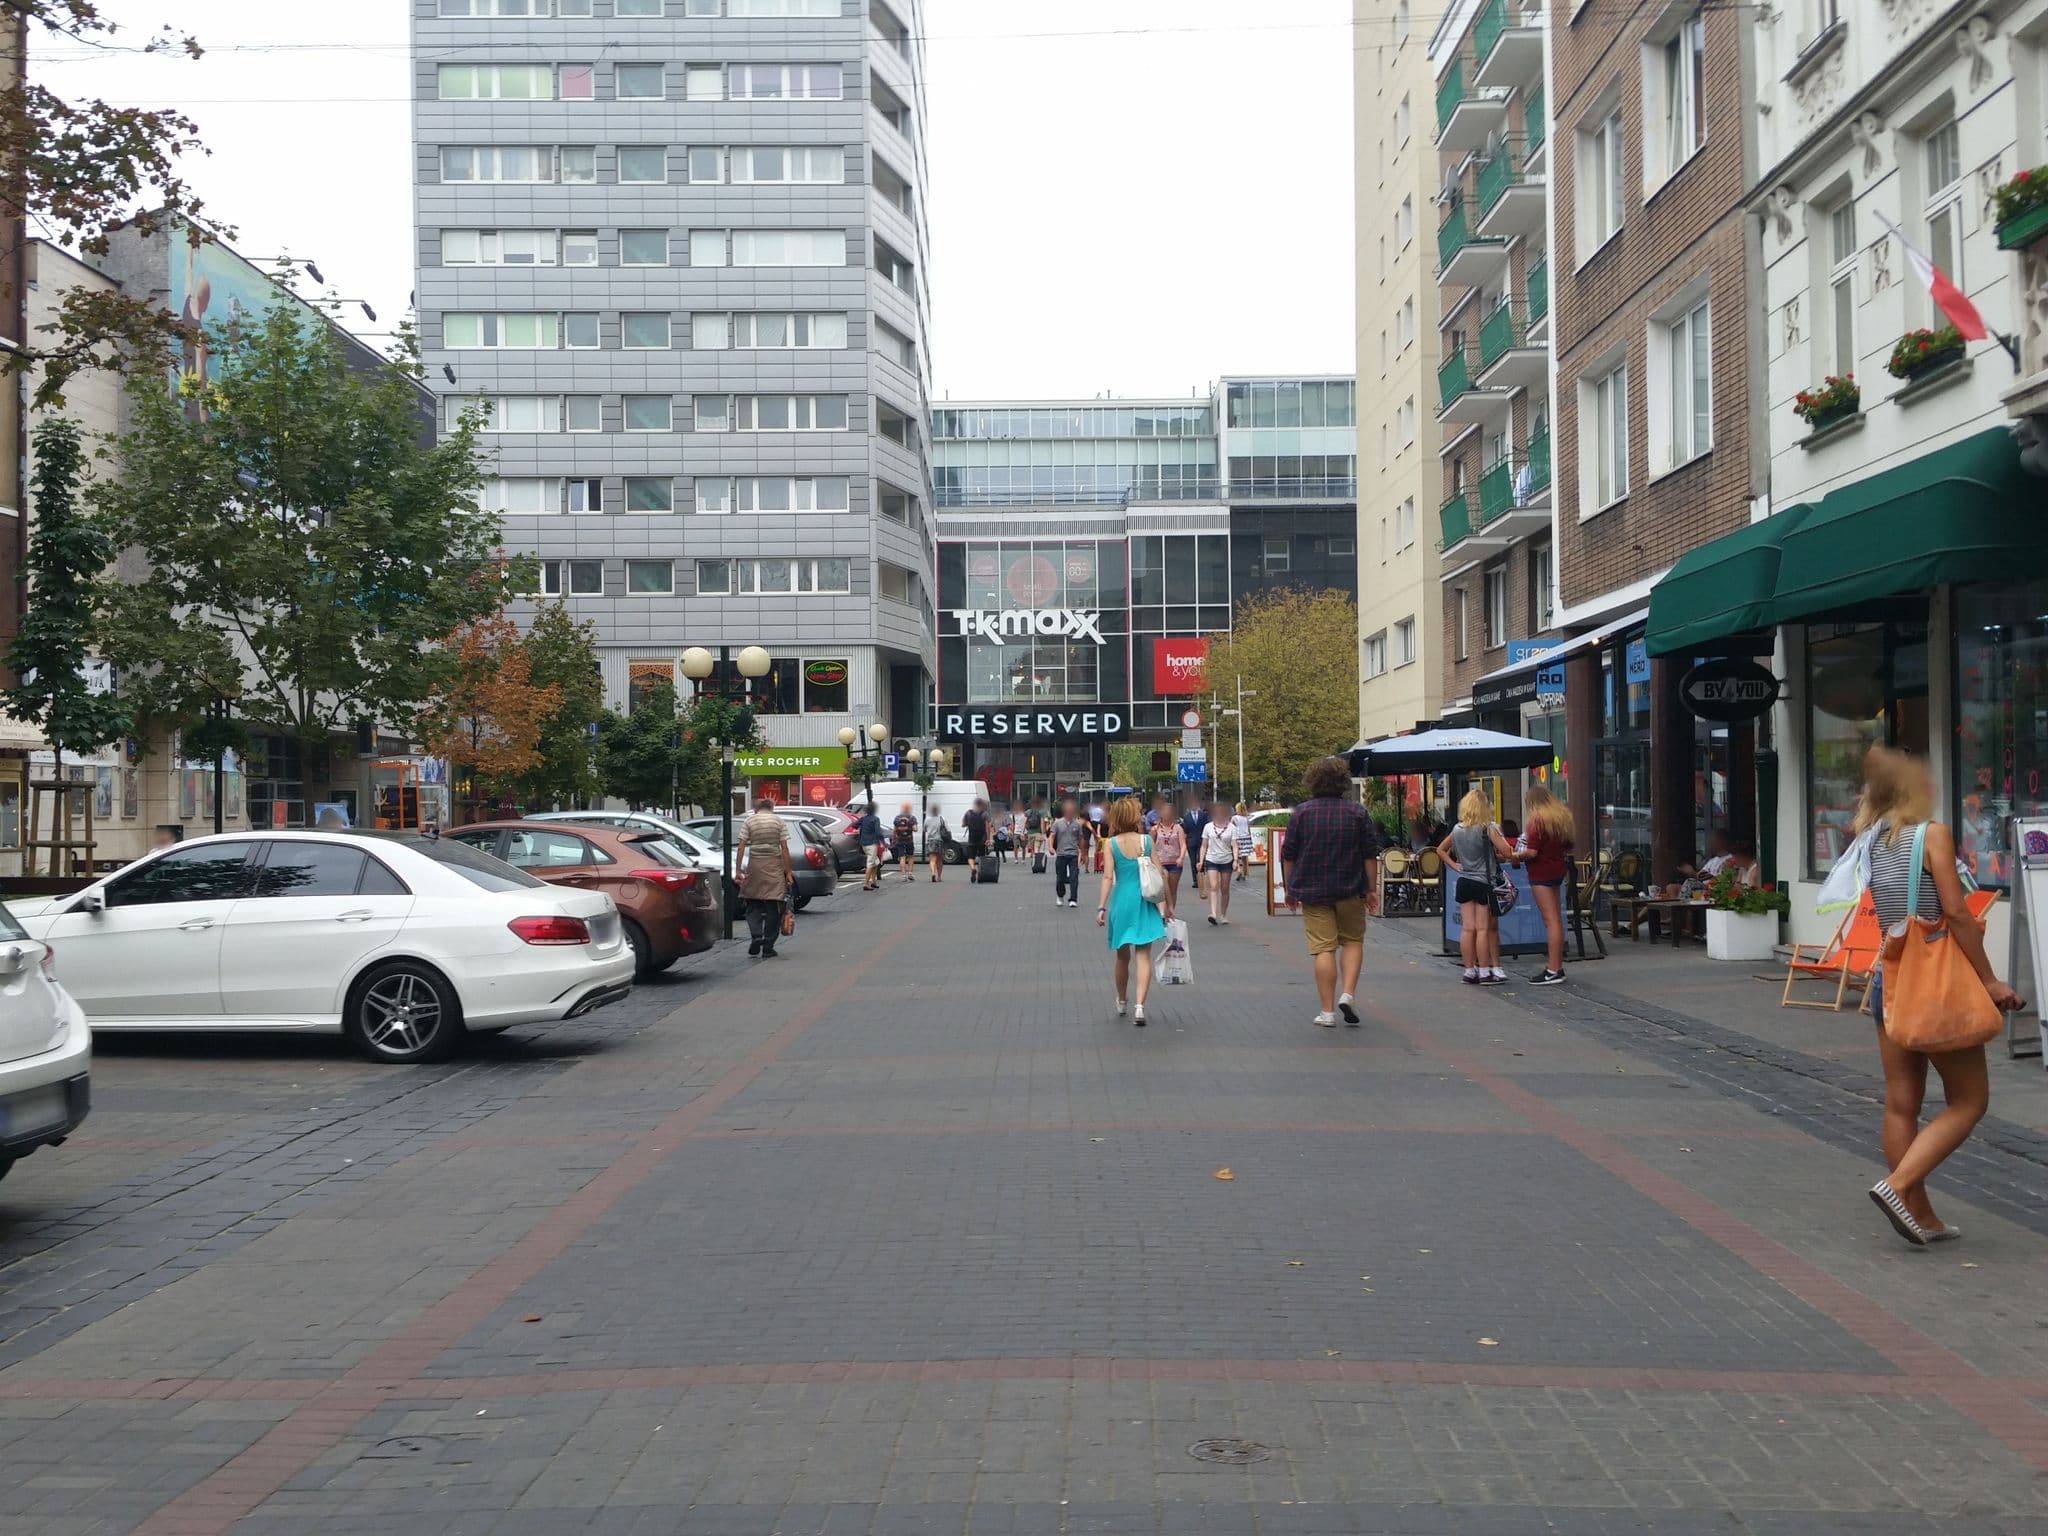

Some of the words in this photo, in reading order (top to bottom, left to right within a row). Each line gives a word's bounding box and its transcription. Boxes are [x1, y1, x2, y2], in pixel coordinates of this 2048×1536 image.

[1166, 653, 1205, 667] home
[946, 713, 1122, 735] RESERVED
[733, 757, 763, 767] YVES
[767, 756, 820, 767] ROCHER
[885, 754, 896, 769] P
